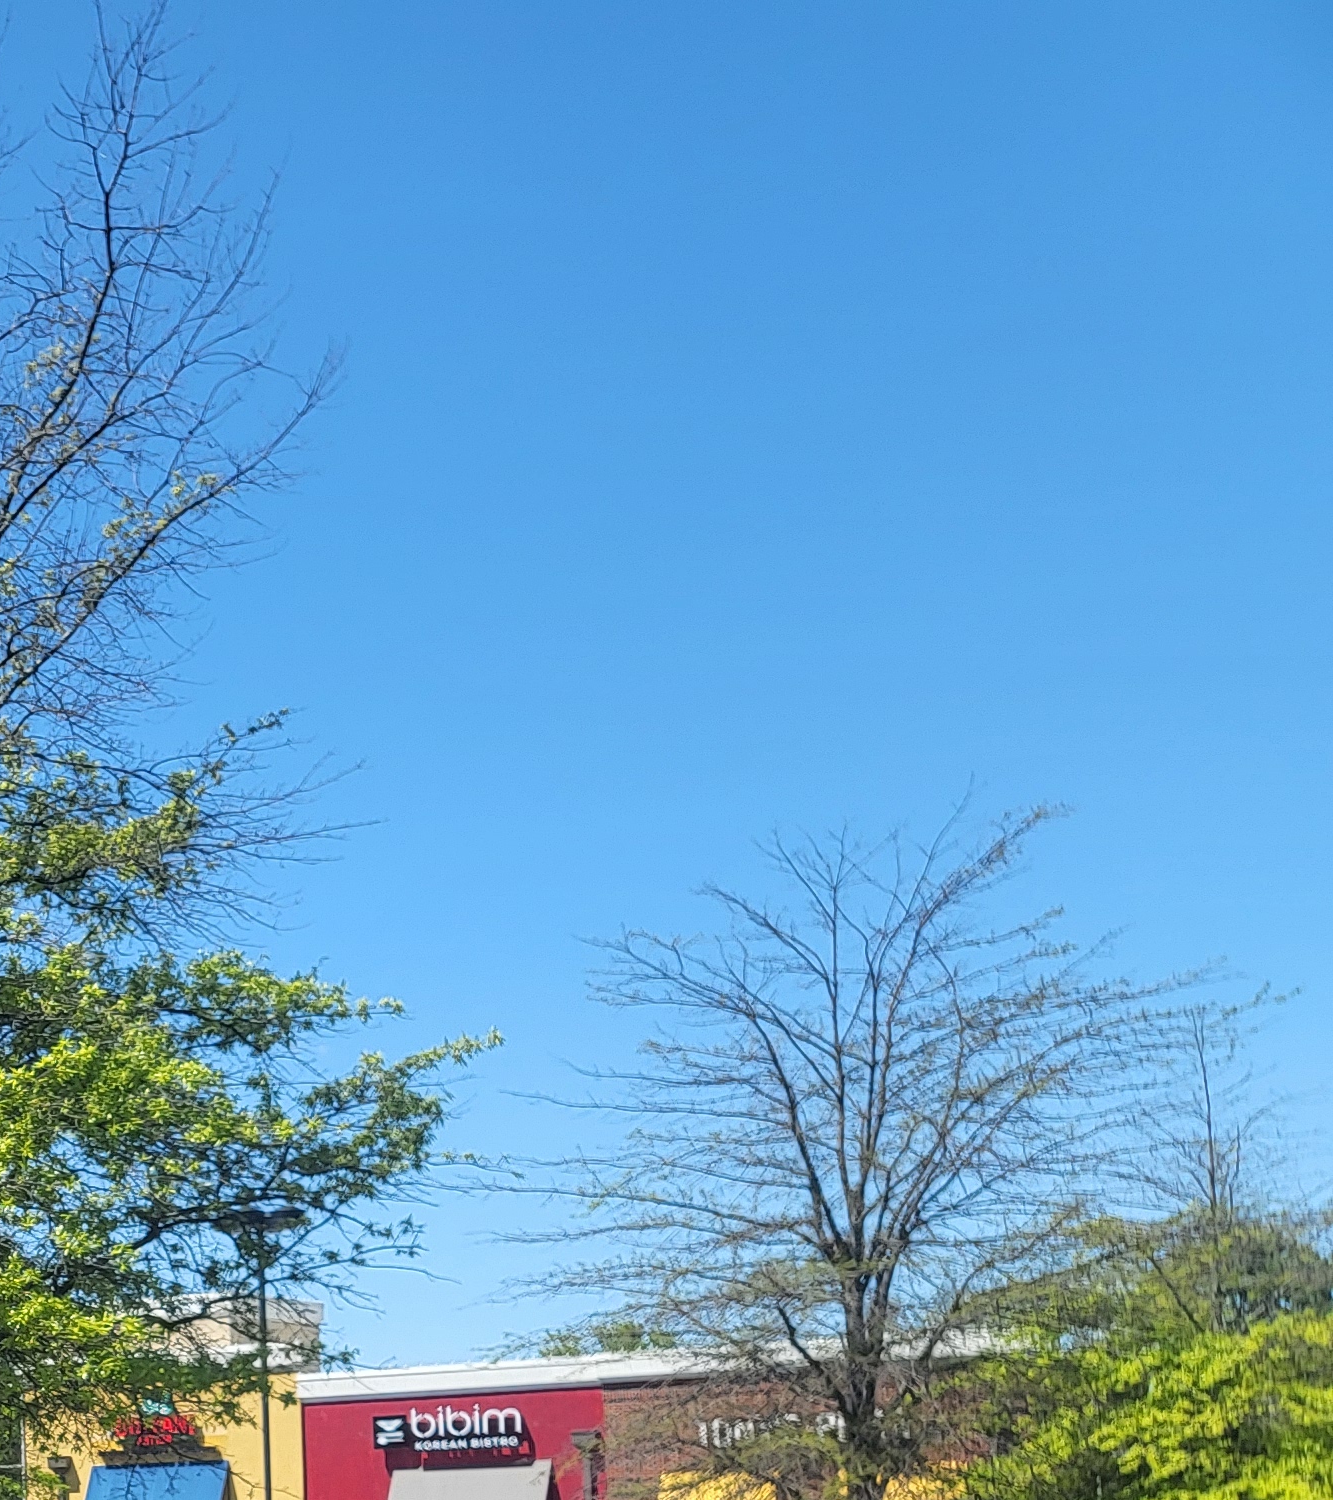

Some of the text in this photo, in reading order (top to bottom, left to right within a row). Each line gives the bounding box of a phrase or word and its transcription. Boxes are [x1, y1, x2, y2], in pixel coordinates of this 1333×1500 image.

[409, 1403, 522, 1438] bibim
[414, 1435, 519, 1451] KOREAN BISTRO
